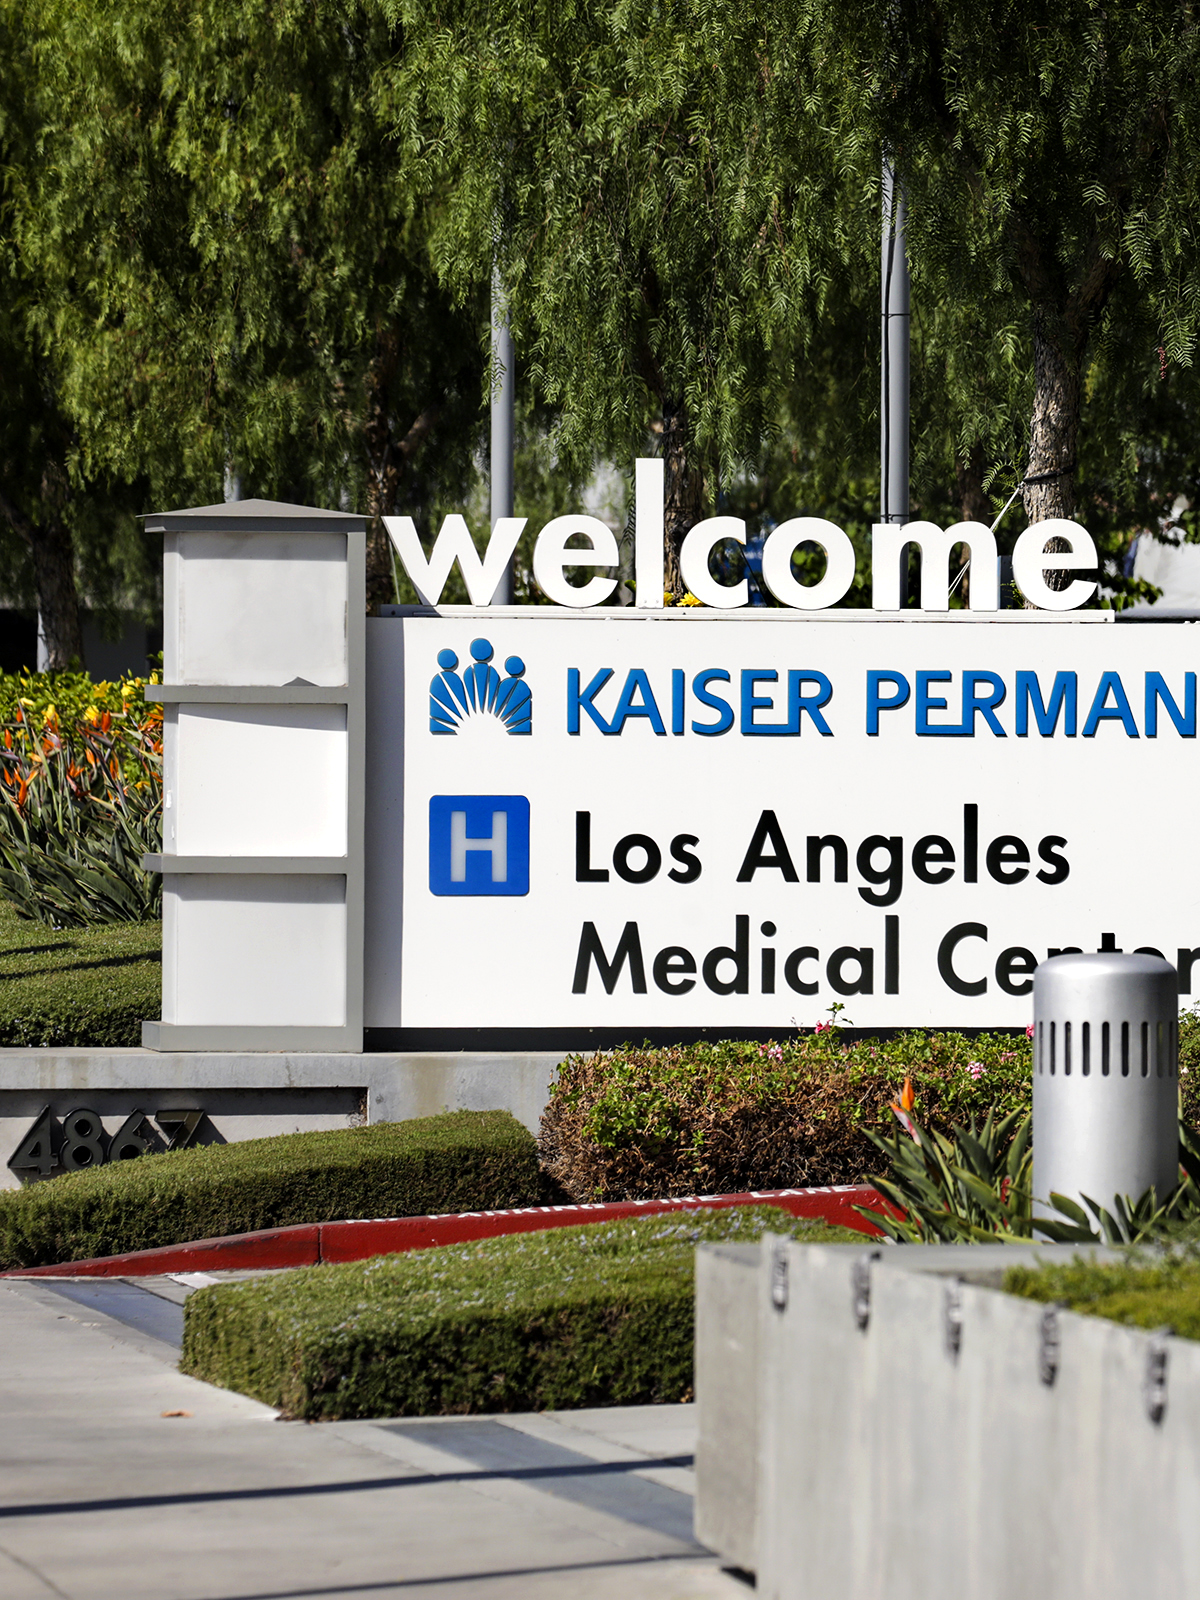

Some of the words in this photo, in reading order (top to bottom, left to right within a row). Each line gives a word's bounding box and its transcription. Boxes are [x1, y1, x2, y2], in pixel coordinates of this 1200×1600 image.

[381, 457, 1099, 611] welcome
[566, 667, 835, 738] KAISER
[450, 811, 508, 883] H
[575, 810, 702, 885] Los
[735, 803, 1071, 907] Angeles
[571, 914, 900, 996] Medical
[7, 1104, 205, 1175] 4867
[749, 1184, 857, 1199] LANE
